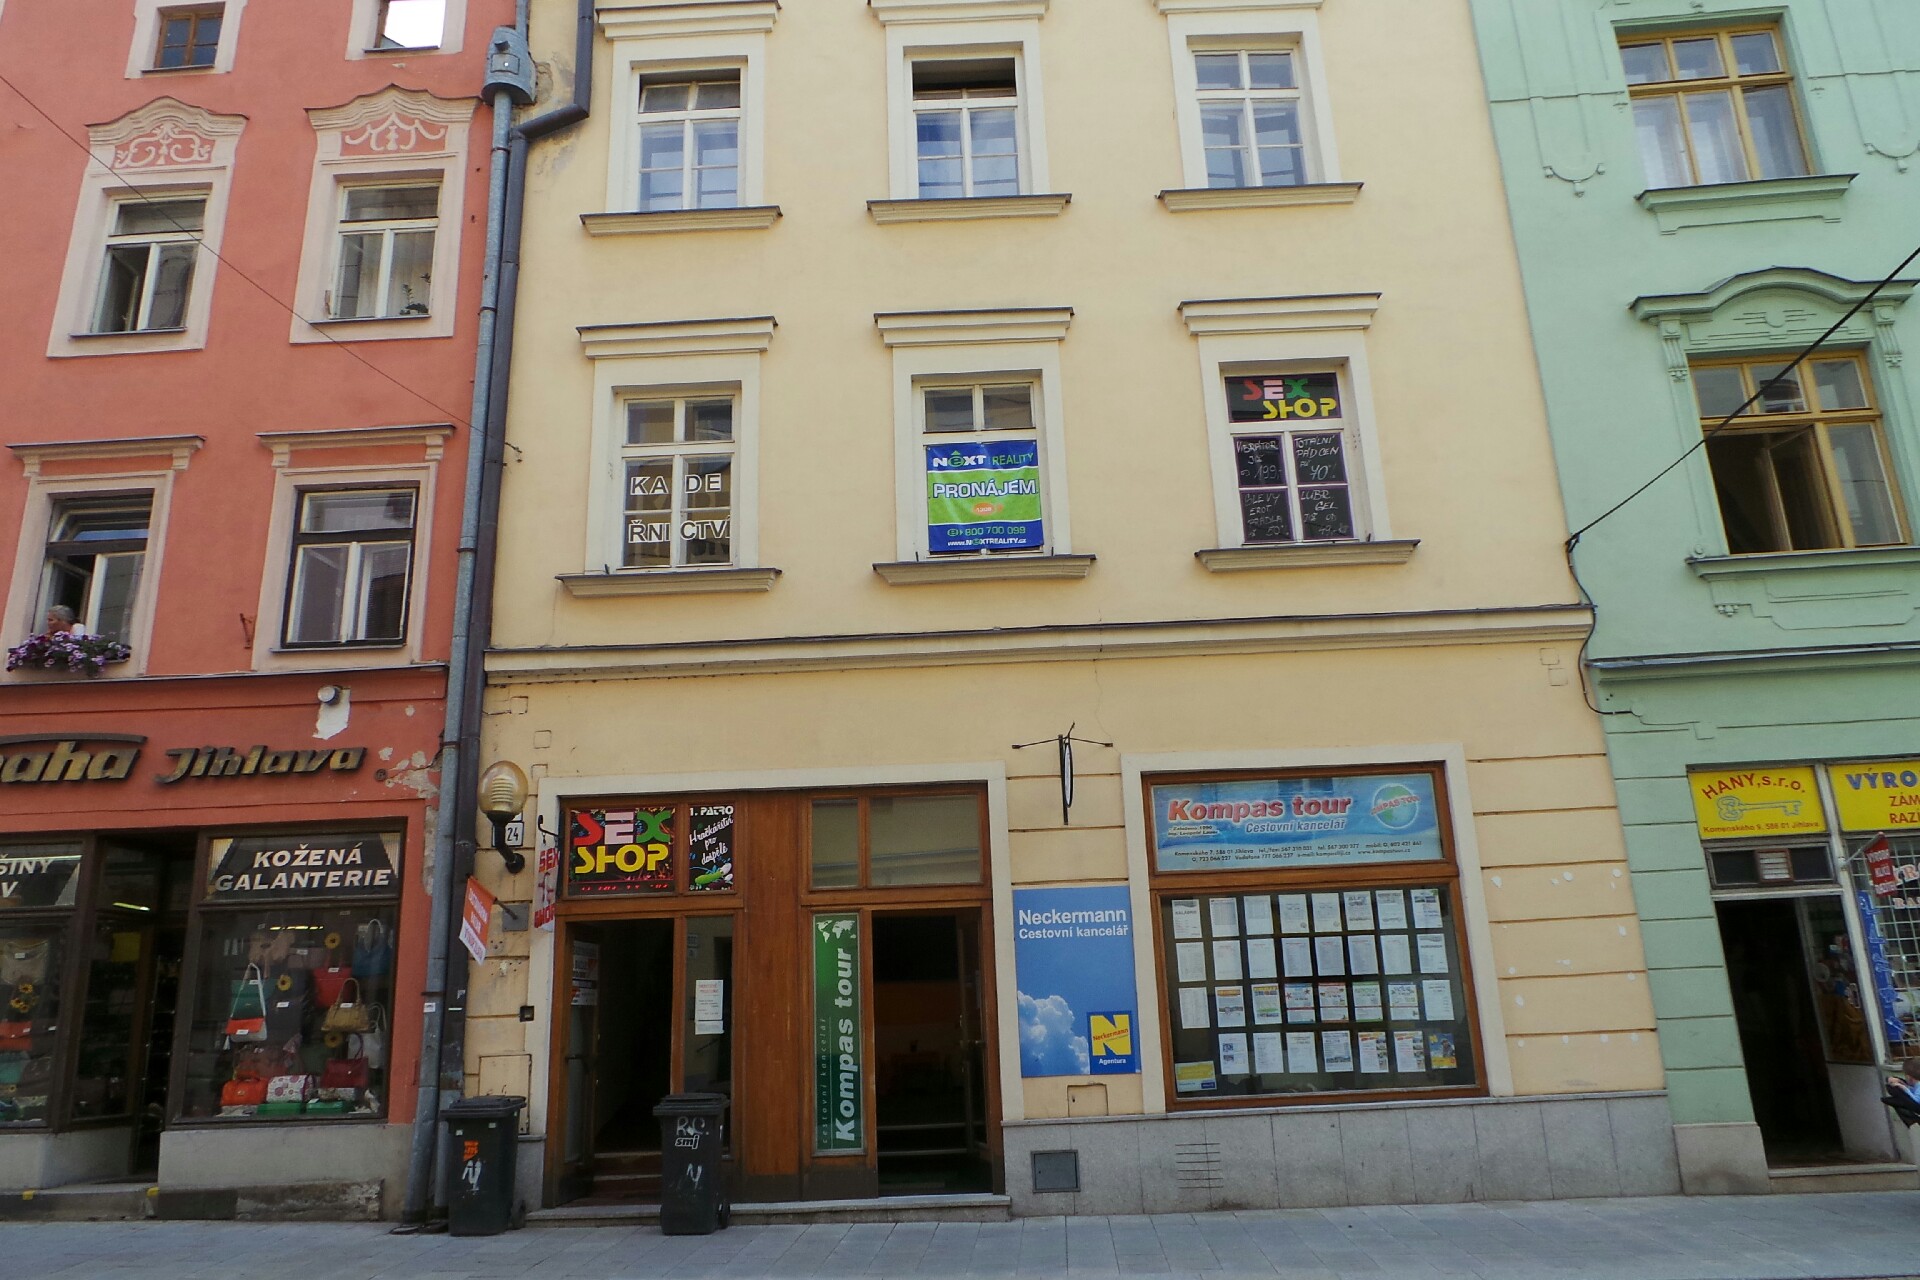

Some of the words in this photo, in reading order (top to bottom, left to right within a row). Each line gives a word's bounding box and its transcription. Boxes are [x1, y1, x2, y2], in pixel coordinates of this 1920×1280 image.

[1242, 378, 1311, 400] SEX
[1262, 397, 1337, 419] SHOP
[992, 453, 1034, 465] REALITY
[933, 477, 1037, 498] PRONÁJEM
[986, 526, 1005, 535] 700
[0, 741, 141, 784] aha
[155, 745, 367, 785] Jihlava
[700, 805, 734, 816] PATRO
[1167, 799, 1285, 823] Kompas
[1291, 796, 1352, 817] tour
[506, 827, 520, 842] 24
[573, 810, 673, 846] SEX
[1245, 822, 1294, 833] Cestovní
[253, 842, 363, 868] KOŽENÁ
[575, 843, 669, 874] SHOP
[214, 869, 391, 892] GALANTERIE
[1019, 909, 1127, 926] Neckermann
[1019, 926, 1073, 939] Cestovní
[1076, 924, 1129, 937] kancelář
[834, 948, 853, 1008] tour
[1093, 1028, 1129, 1041] Neckermann
[1099, 1057, 1127, 1065] Agentura
[835, 1018, 859, 1142] Kompas
[675, 1135, 700, 1150] smj
